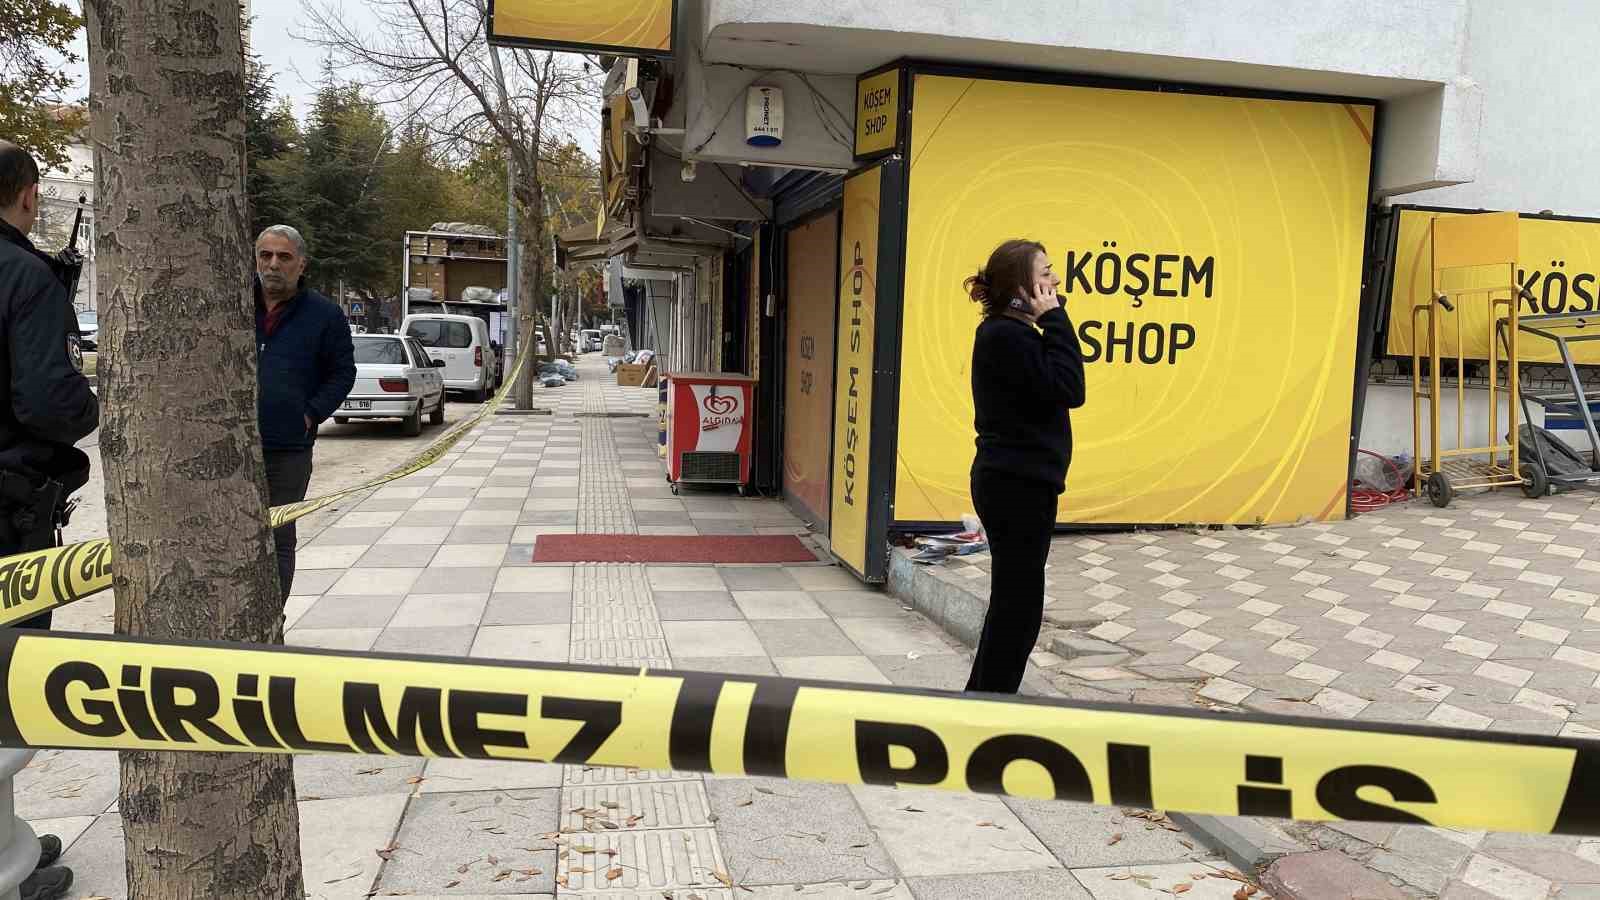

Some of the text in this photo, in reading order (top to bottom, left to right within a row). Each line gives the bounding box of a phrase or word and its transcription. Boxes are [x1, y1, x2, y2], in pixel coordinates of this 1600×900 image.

[865, 115, 887, 136] SHOP
[1064, 240, 1215, 308] KÖŞEM
[1078, 319, 1196, 365] SHOP
[843, 240, 864, 506] KÖŞEM SHOP
[702, 416, 737, 425] ALGIDA
